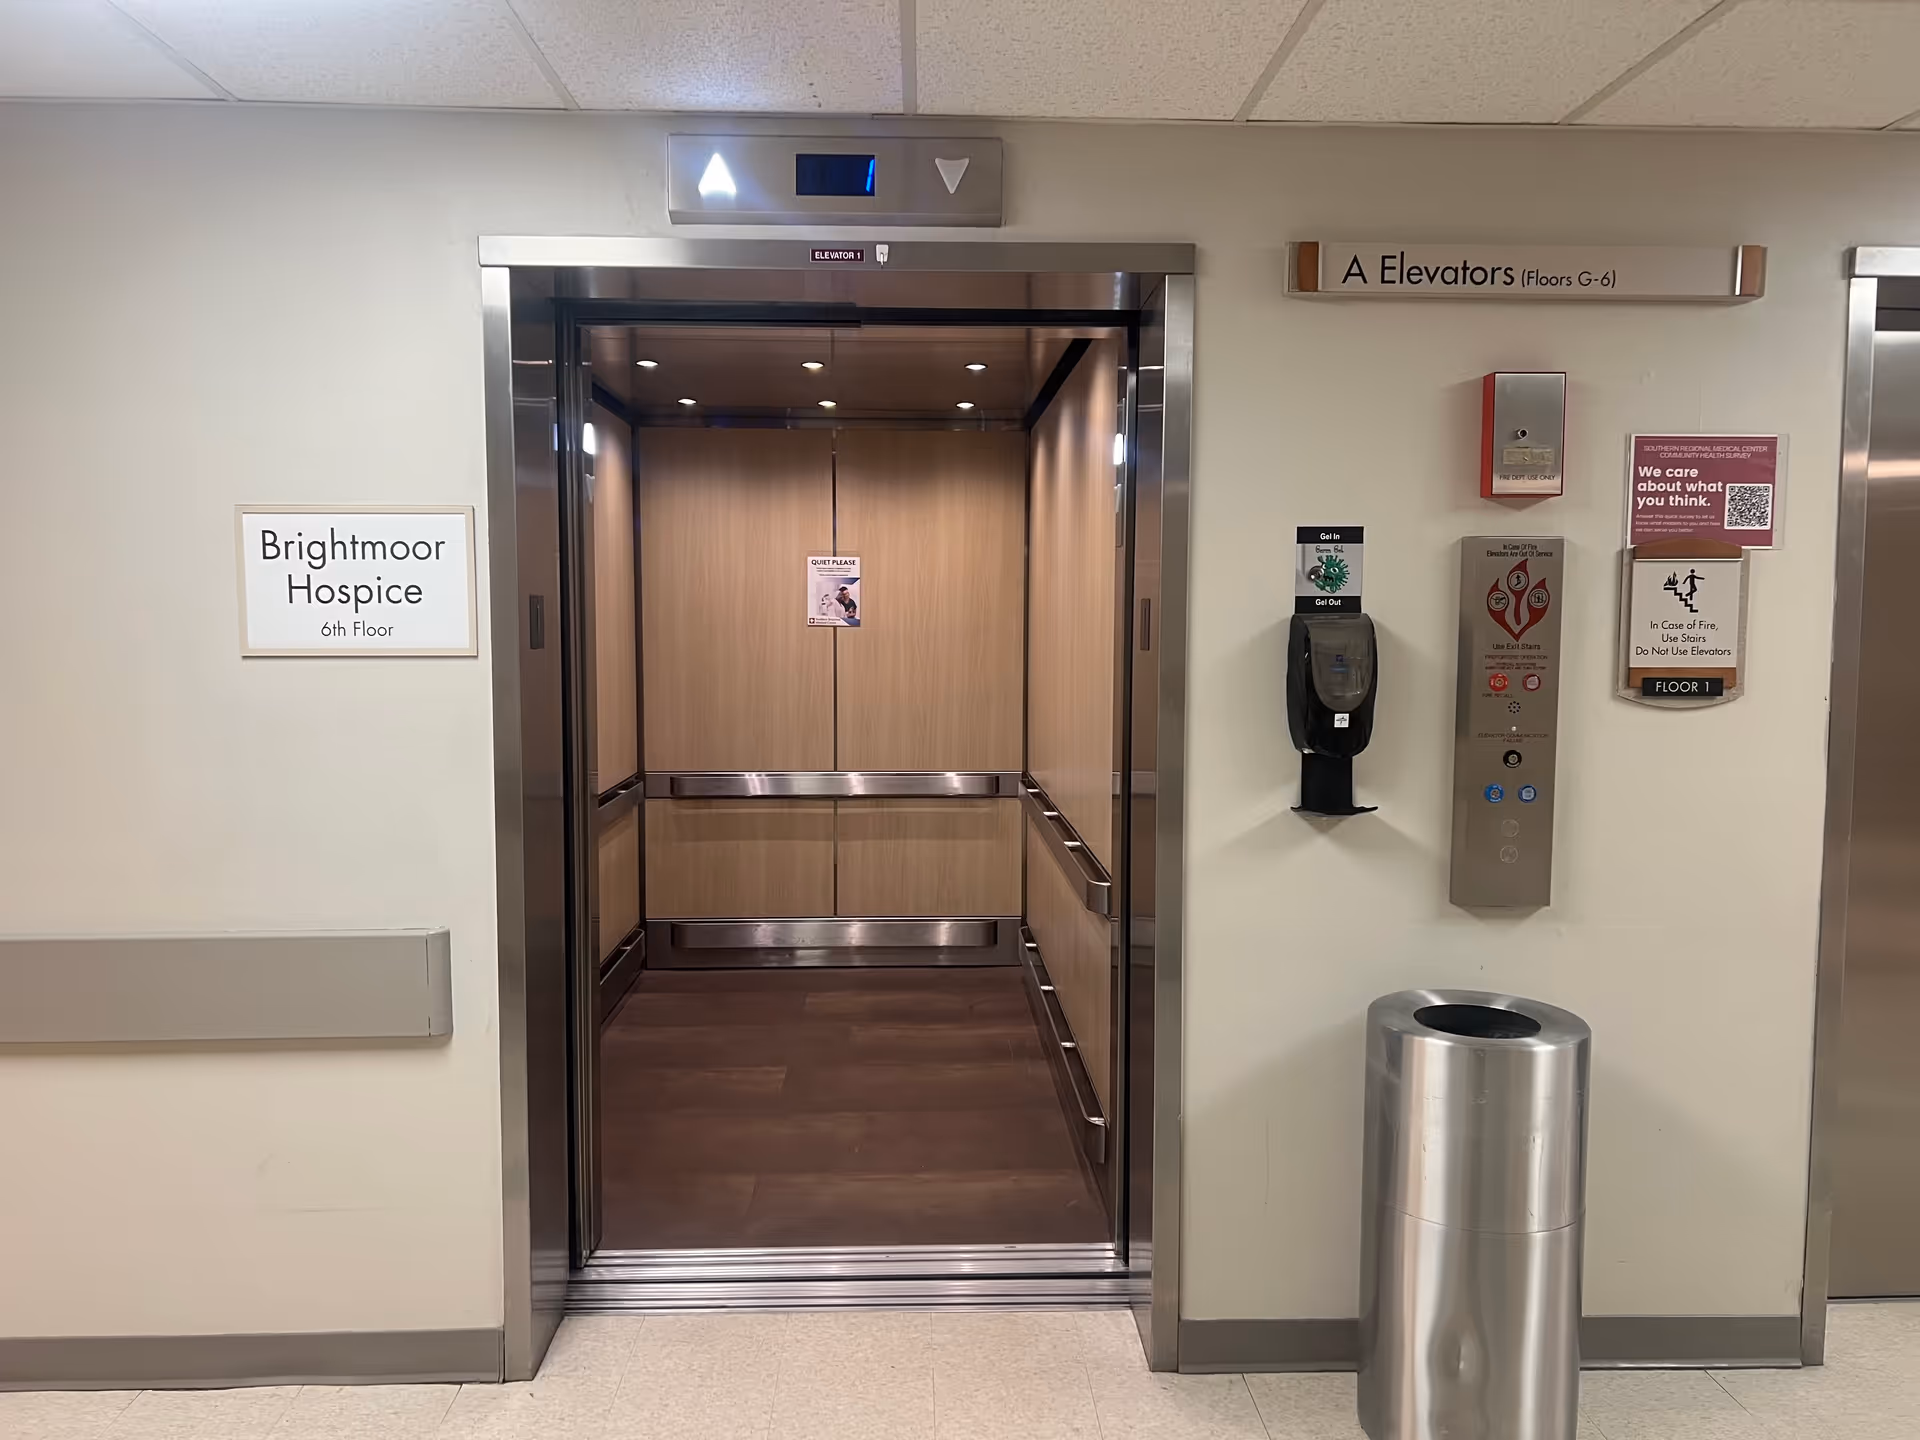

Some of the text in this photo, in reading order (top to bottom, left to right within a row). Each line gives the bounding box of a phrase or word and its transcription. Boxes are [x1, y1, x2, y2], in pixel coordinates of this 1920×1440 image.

[814, 251, 861, 260] ELEVATOR 1
[1341, 250, 1617, 288] A Elevators (Floors G-6)
[1638, 466, 1699, 478] We care
[1637, 480, 1723, 492] about what
[1636, 494, 1711, 510] you think.
[1320, 532, 1340, 540] Gel In
[261, 527, 445, 570] Brightmoor
[287, 573, 423, 613] Hospice
[1315, 598, 1342, 606] Gel Out
[320, 620, 394, 637] 6th Floor
[1650, 619, 1719, 631] In Case of Fire,
[1661, 633, 1707, 643] Use Stairs
[1506, 642, 1520, 650] Exit
[1635, 645, 1732, 656] Do Not Use Elevators
[1655, 681, 1710, 693] FLOOR 1
